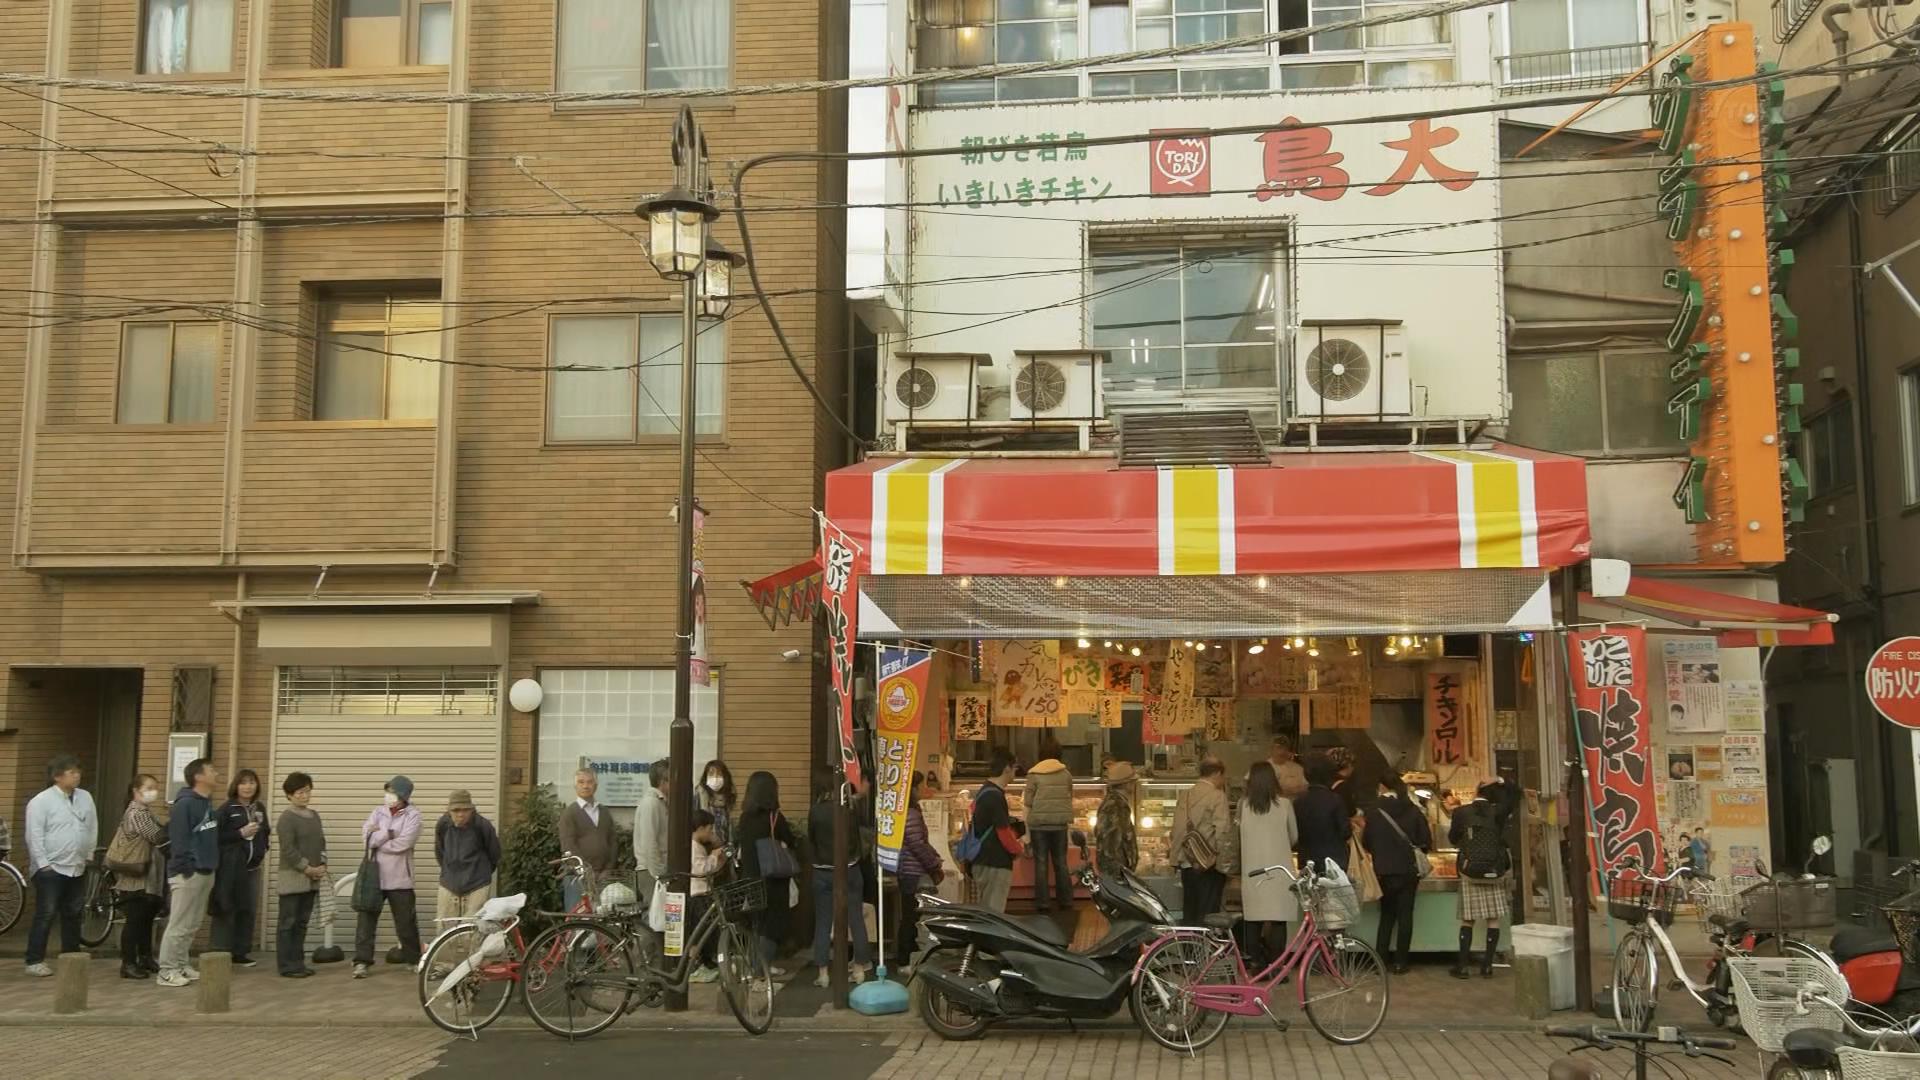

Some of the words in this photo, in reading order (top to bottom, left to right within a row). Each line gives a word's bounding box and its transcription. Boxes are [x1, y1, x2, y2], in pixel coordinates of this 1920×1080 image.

[938, 176, 1112, 208] いきいきチキン
